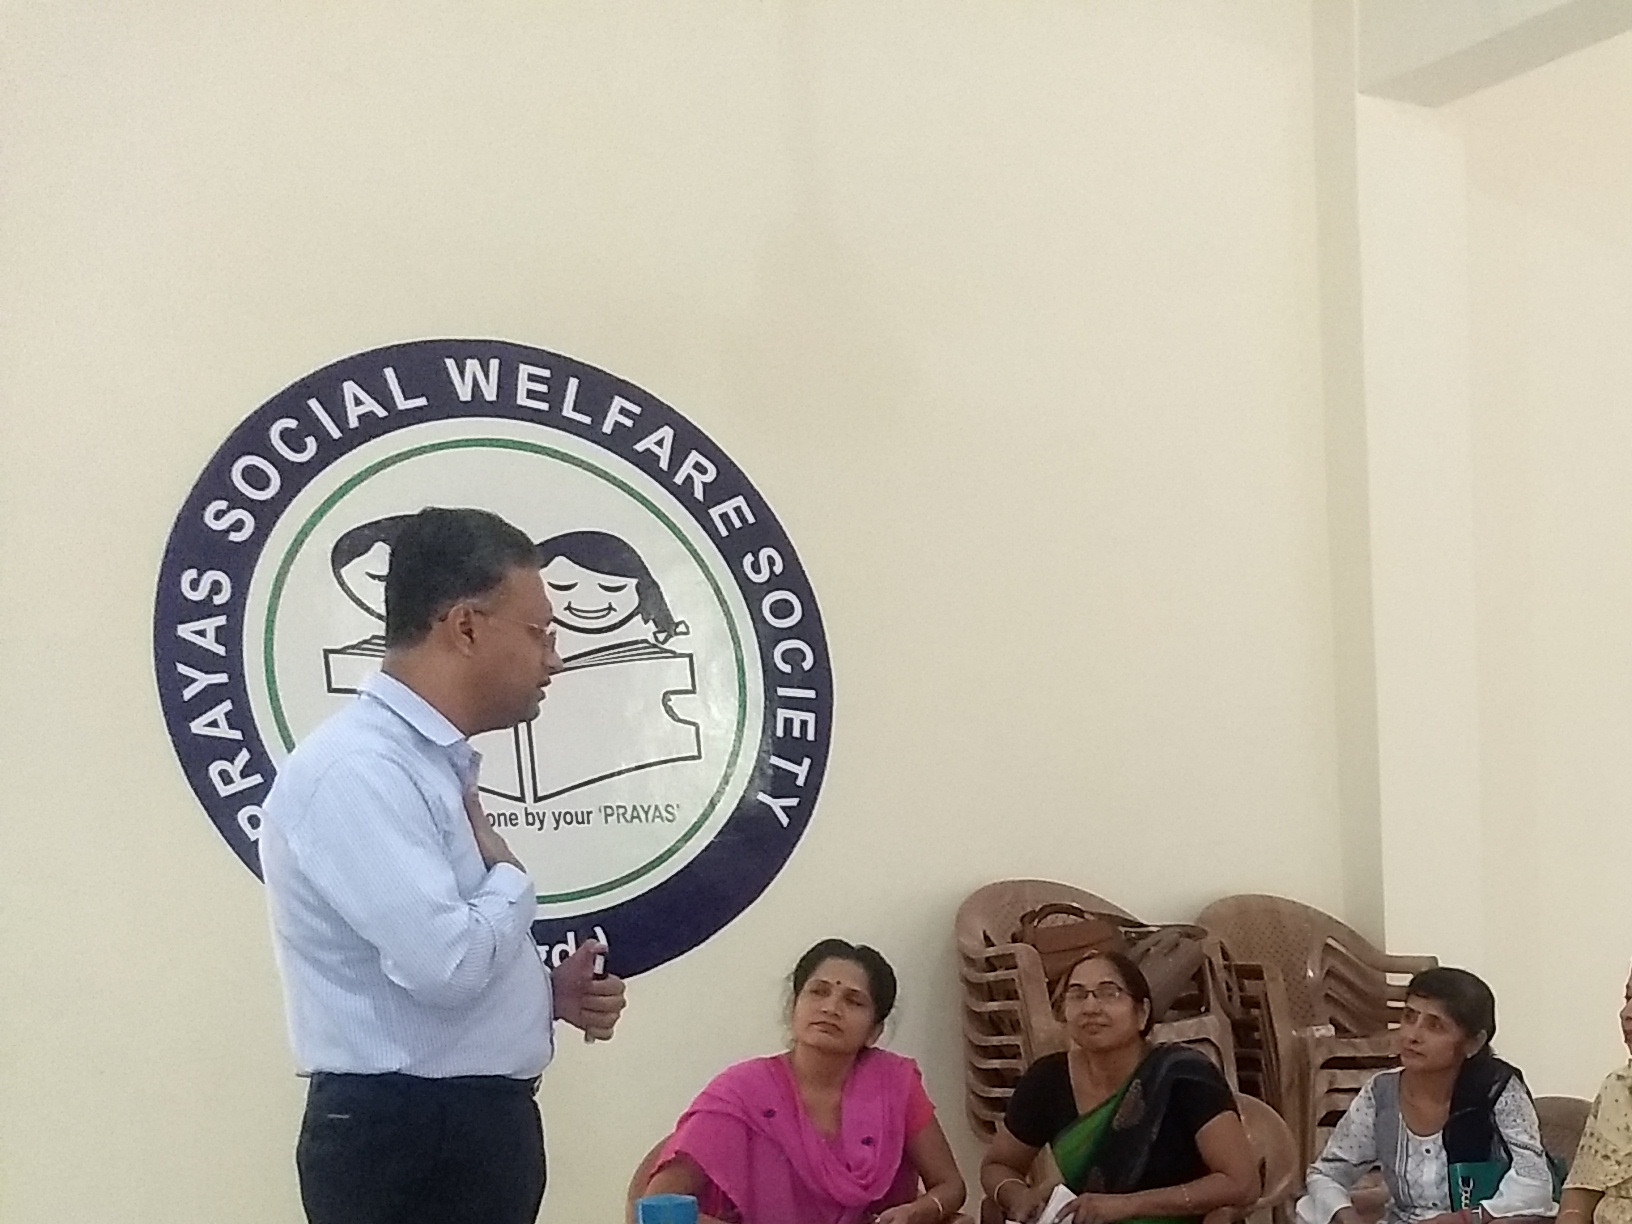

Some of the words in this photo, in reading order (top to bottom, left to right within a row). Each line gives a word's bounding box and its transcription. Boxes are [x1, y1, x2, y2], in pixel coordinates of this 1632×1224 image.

[203, 366, 429, 543] SOCIAL
[444, 357, 756, 538] WELFARE
[743, 546, 818, 829] SOCIETY
[523, 807, 549, 832] by
[552, 809, 594, 831] your
